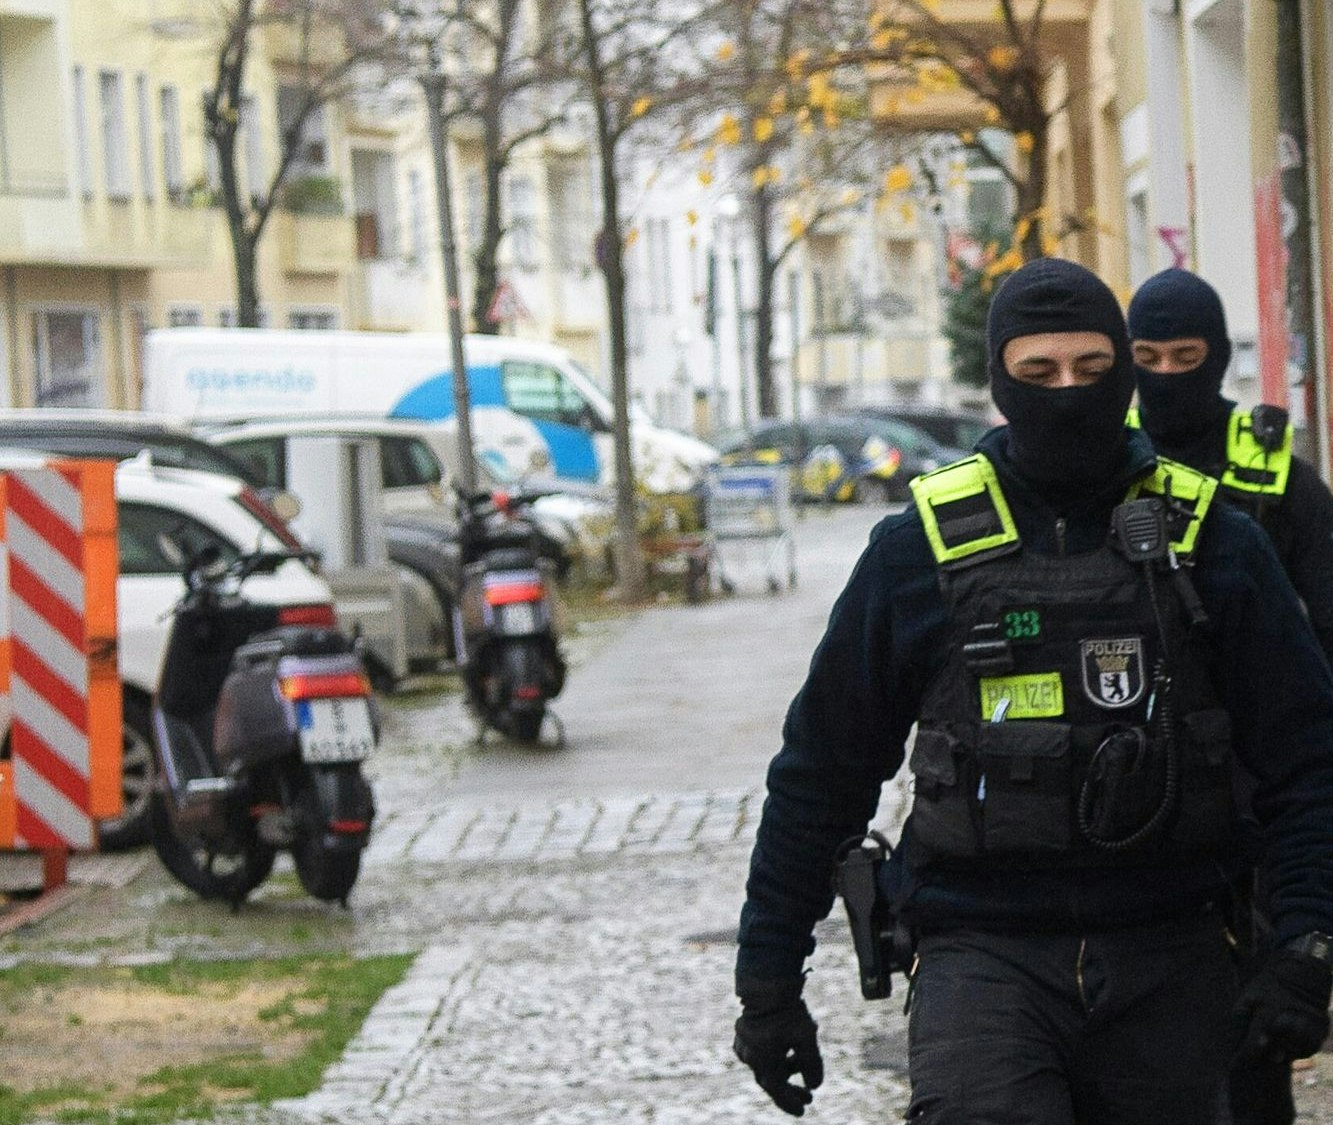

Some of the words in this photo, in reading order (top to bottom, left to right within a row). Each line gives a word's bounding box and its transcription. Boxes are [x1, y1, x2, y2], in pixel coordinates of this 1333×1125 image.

[1004, 610, 1041, 638] 33
[1086, 640, 1137, 657] POLIZEI
[986, 682, 1059, 712] POLIZEI
